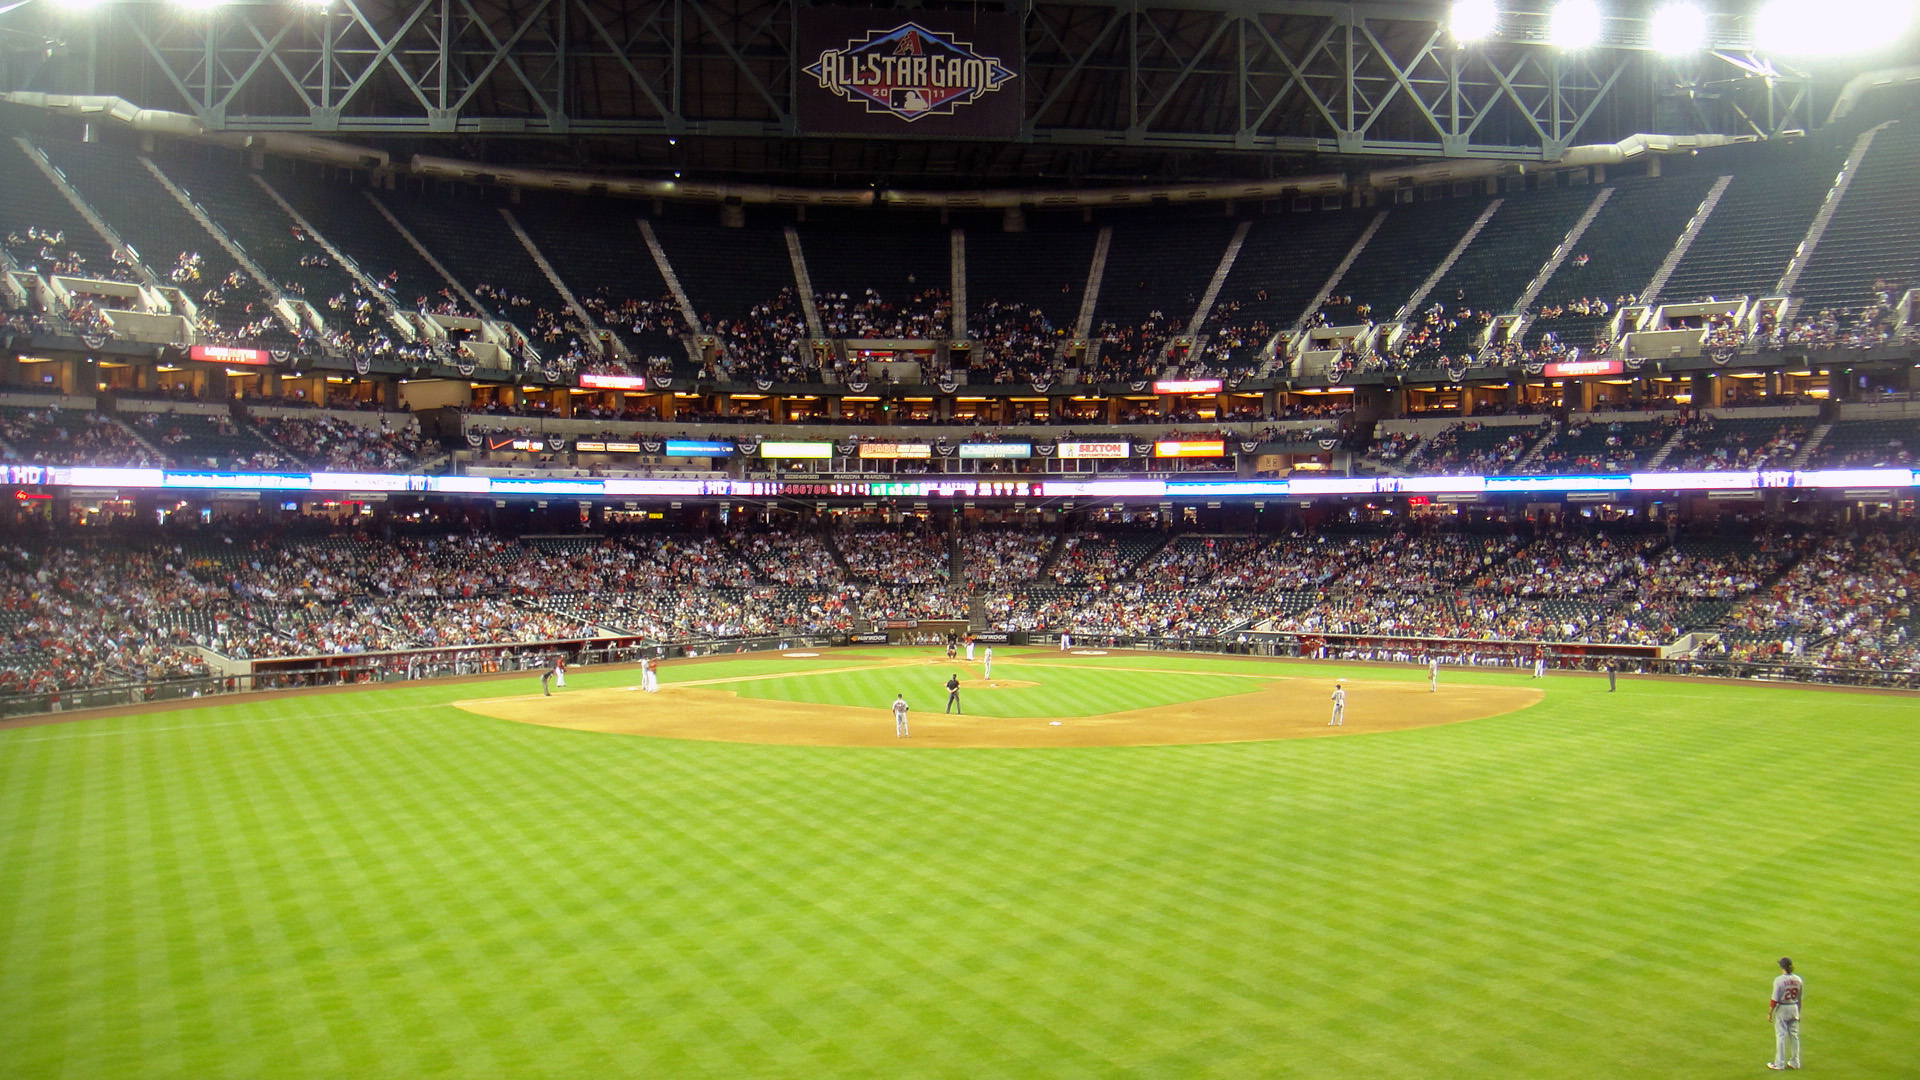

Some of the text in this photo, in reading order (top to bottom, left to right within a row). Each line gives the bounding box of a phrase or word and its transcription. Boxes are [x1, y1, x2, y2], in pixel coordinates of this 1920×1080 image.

[868, 53, 927, 86] STAR
[931, 55, 998, 99] GAME
[513, 440, 543, 452] verizon
[1079, 444, 1121, 452] SEXTON
[15, 466, 41, 484] HD
[1785, 987, 1798, 1000] 28
